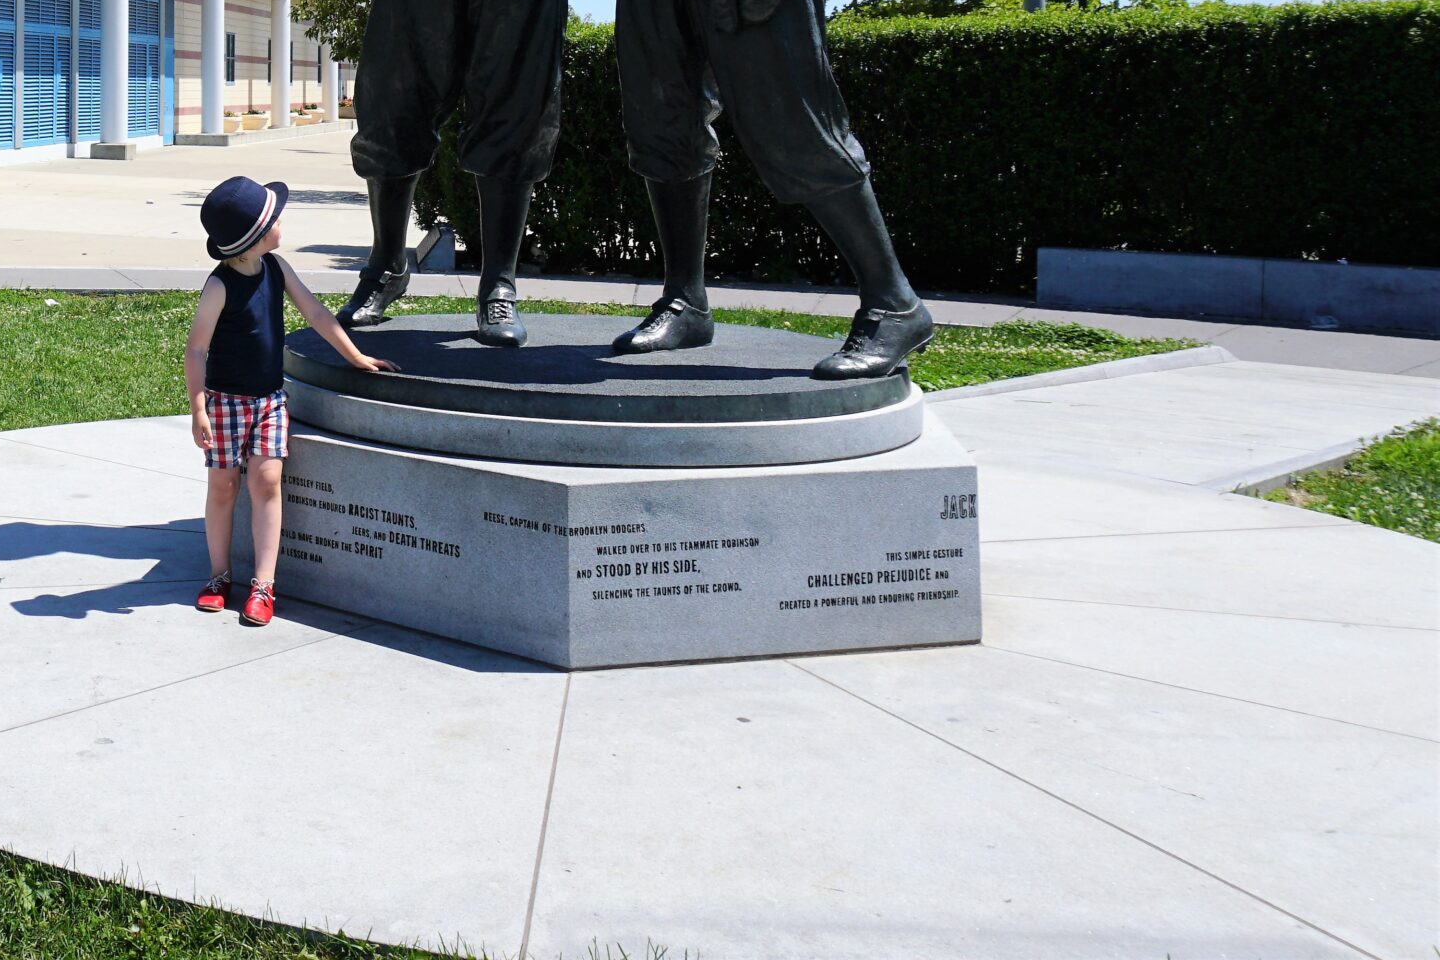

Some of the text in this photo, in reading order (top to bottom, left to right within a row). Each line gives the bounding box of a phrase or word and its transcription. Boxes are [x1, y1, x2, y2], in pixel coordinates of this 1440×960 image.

[287, 494, 317, 508] ROBINSON
[318, 500, 346, 514] ENDURED
[348, 503, 379, 522] RACIST
[940, 494, 977, 520] JACK
[484, 512, 508, 526] REESE,
[509, 516, 539, 531] CAPTAIN
[542, 523, 551, 533] OF
[553, 525, 568, 537] THE
[568, 525, 608, 537] BROOKLYN
[286, 548, 308, 560] LESSER
[315, 535, 339, 548] BROKEN
[341, 541, 353, 553] THE
[354, 542, 384, 560] SPIRIT
[373, 530, 386, 542] AND
[389, 531, 417, 549] DEATH
[420, 537, 461, 558] THREATS
[596, 538, 759, 556] WALKED OVER TO HIS TEAMMATE ROBINSON
[886, 548, 963, 561] THIS SIMPLE GESTURE
[576, 559, 701, 579] AND STOOD BY HIS SIDE,
[808, 568, 949, 588] CHALLENGED PREJUDICE AND
[592, 588, 633, 600] SILENCING
[636, 587, 651, 598] THE
[653, 586, 681, 597] TAUNTS
[683, 585, 693, 595] OF
[695, 584, 710, 594] THE
[779, 599, 811, 610] CREATED
[813, 599, 819, 608] A
[821, 596, 859, 607] POWERFUL
[862, 595, 876, 605] AND
[879, 592, 915, 604] ENDURING
